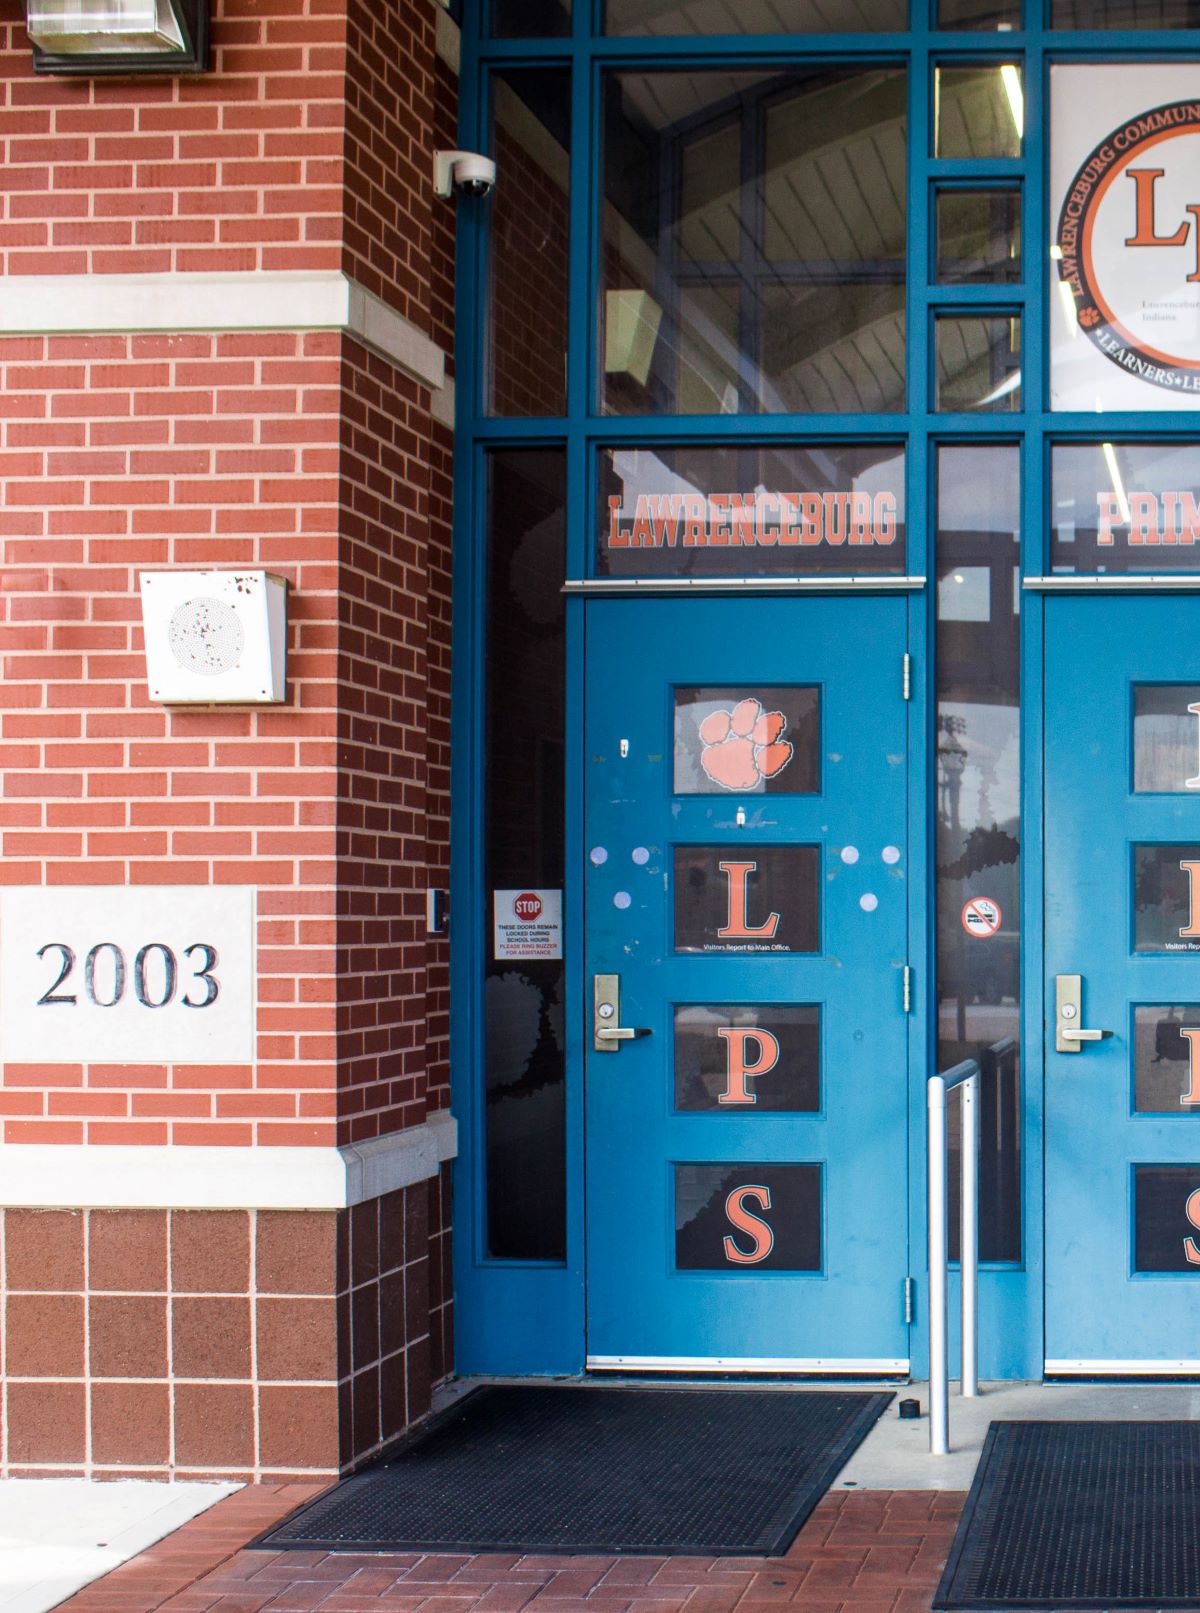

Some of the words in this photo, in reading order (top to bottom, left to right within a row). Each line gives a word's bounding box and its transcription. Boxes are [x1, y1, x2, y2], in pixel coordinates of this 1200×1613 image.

[1062, 146, 1116, 297] LAWRENCEBURG
[1098, 332, 1176, 385] LEARNERS
[608, 492, 896, 547] LAWRENCEBURG
[516, 901, 541, 913] STOP
[718, 861, 780, 937] L
[36, 943, 220, 1008] 2003
[726, 943, 746, 951] Report
[718, 1027, 780, 1103] P
[723, 1184, 774, 1264] S
